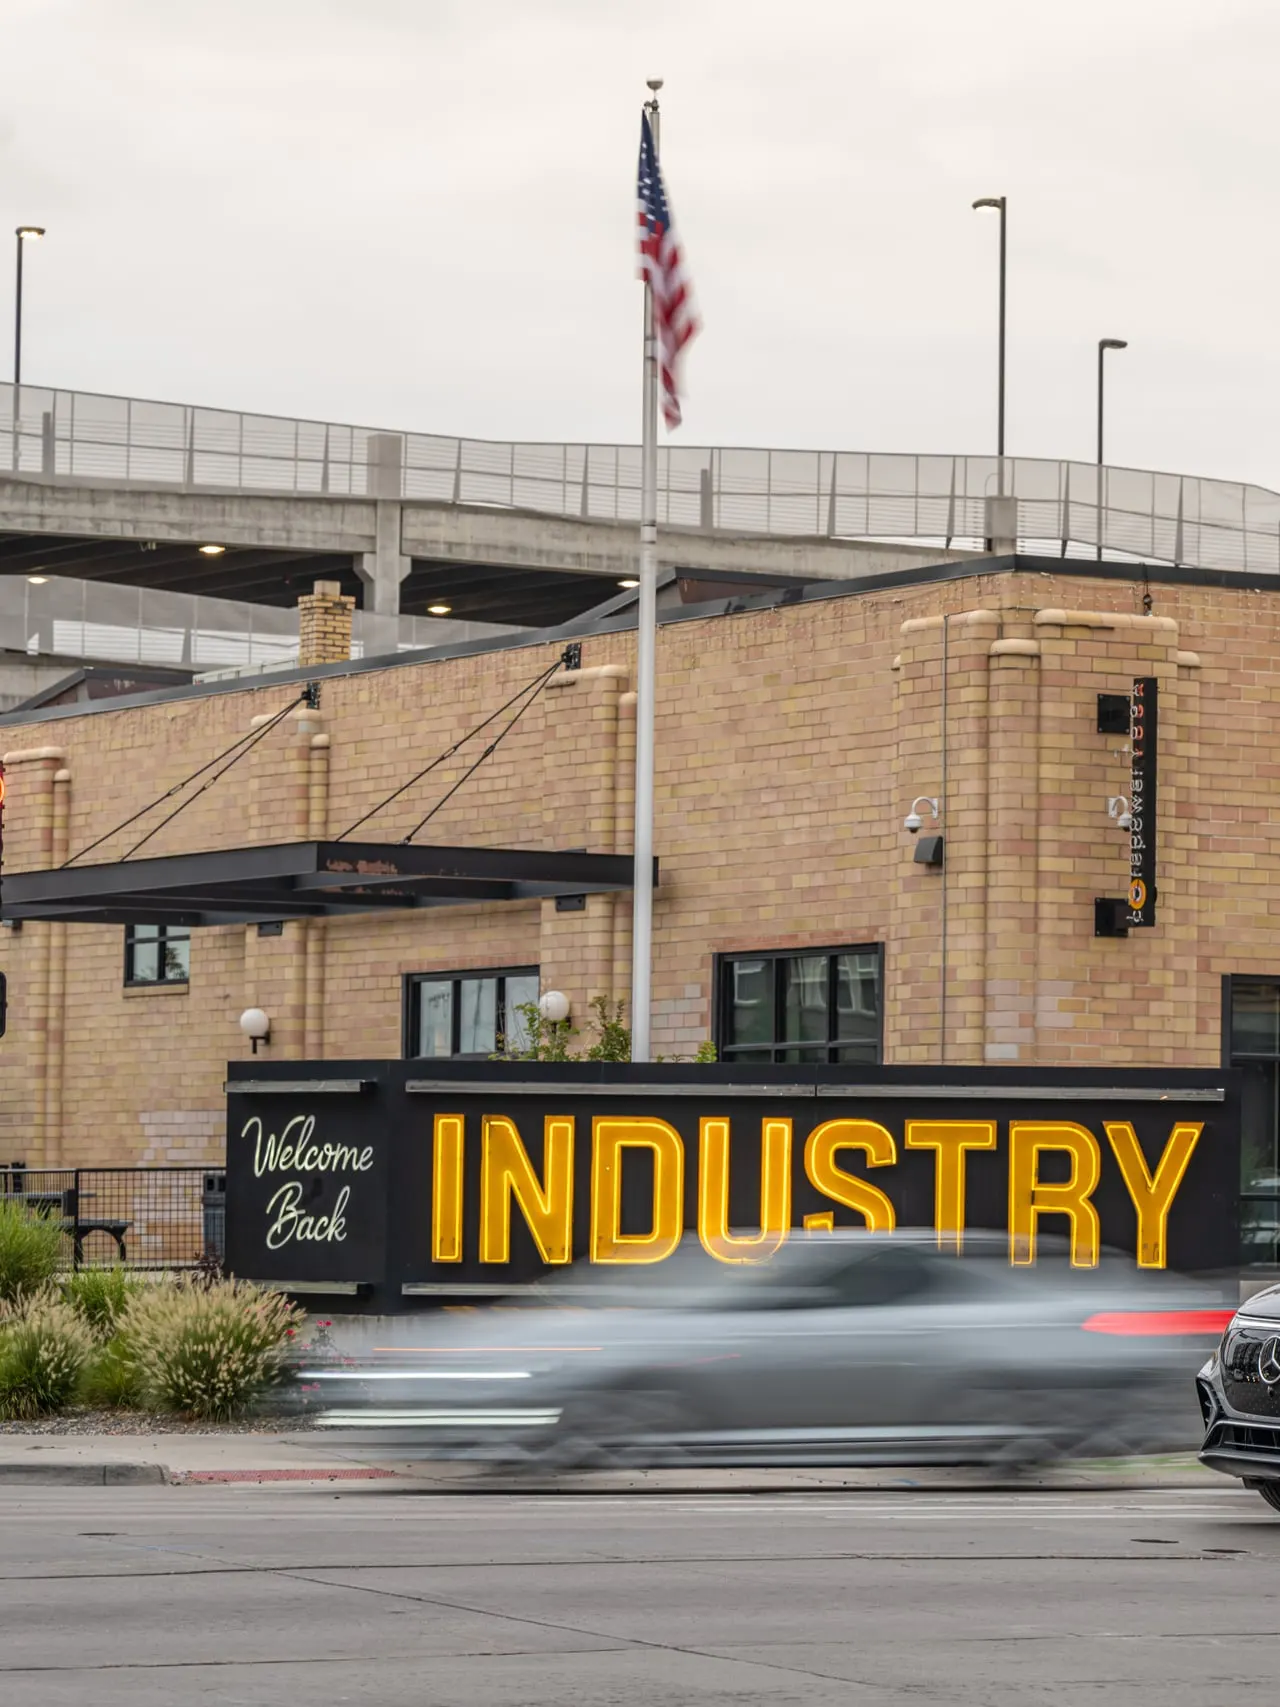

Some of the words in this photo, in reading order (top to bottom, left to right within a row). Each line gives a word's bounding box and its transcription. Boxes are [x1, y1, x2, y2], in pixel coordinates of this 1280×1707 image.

[241, 1114, 374, 1178] Welcome
[265, 1181, 351, 1250] Back
[431, 1113, 1205, 1269] INDUSTRY
